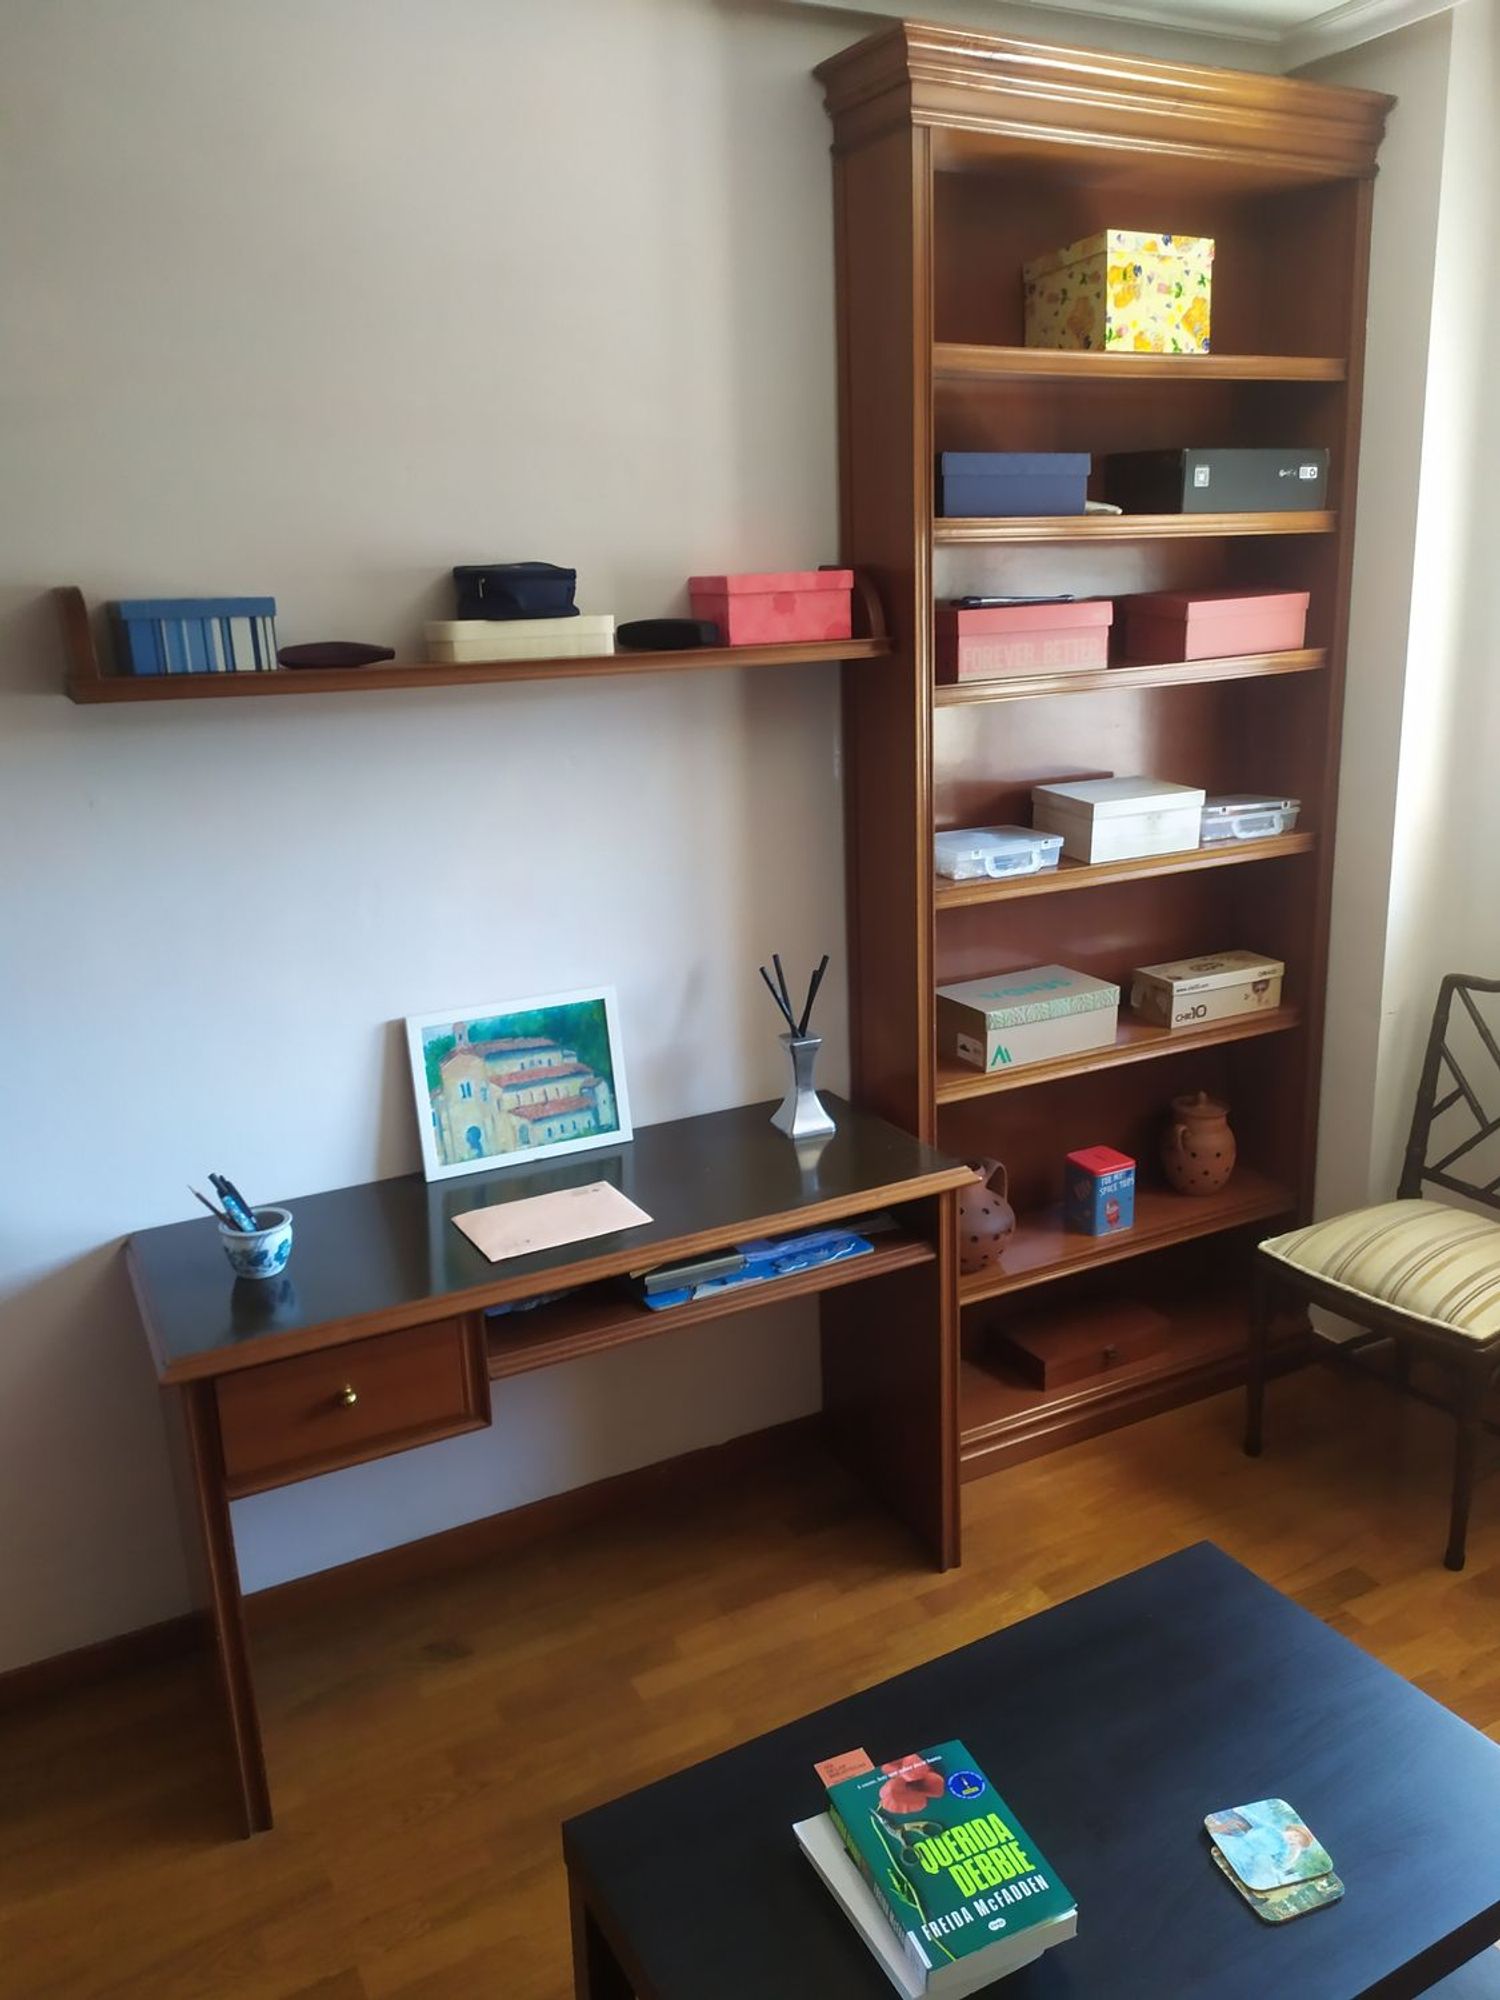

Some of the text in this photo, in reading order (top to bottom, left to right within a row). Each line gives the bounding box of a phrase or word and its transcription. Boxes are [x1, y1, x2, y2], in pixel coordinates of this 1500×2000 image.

[914, 1813, 1015, 1874] QUERIDA
[948, 1841, 1036, 1898] DEBBIE
[921, 1907, 974, 1941] FREIDA
[973, 1874, 1049, 1917] McFADDEN
